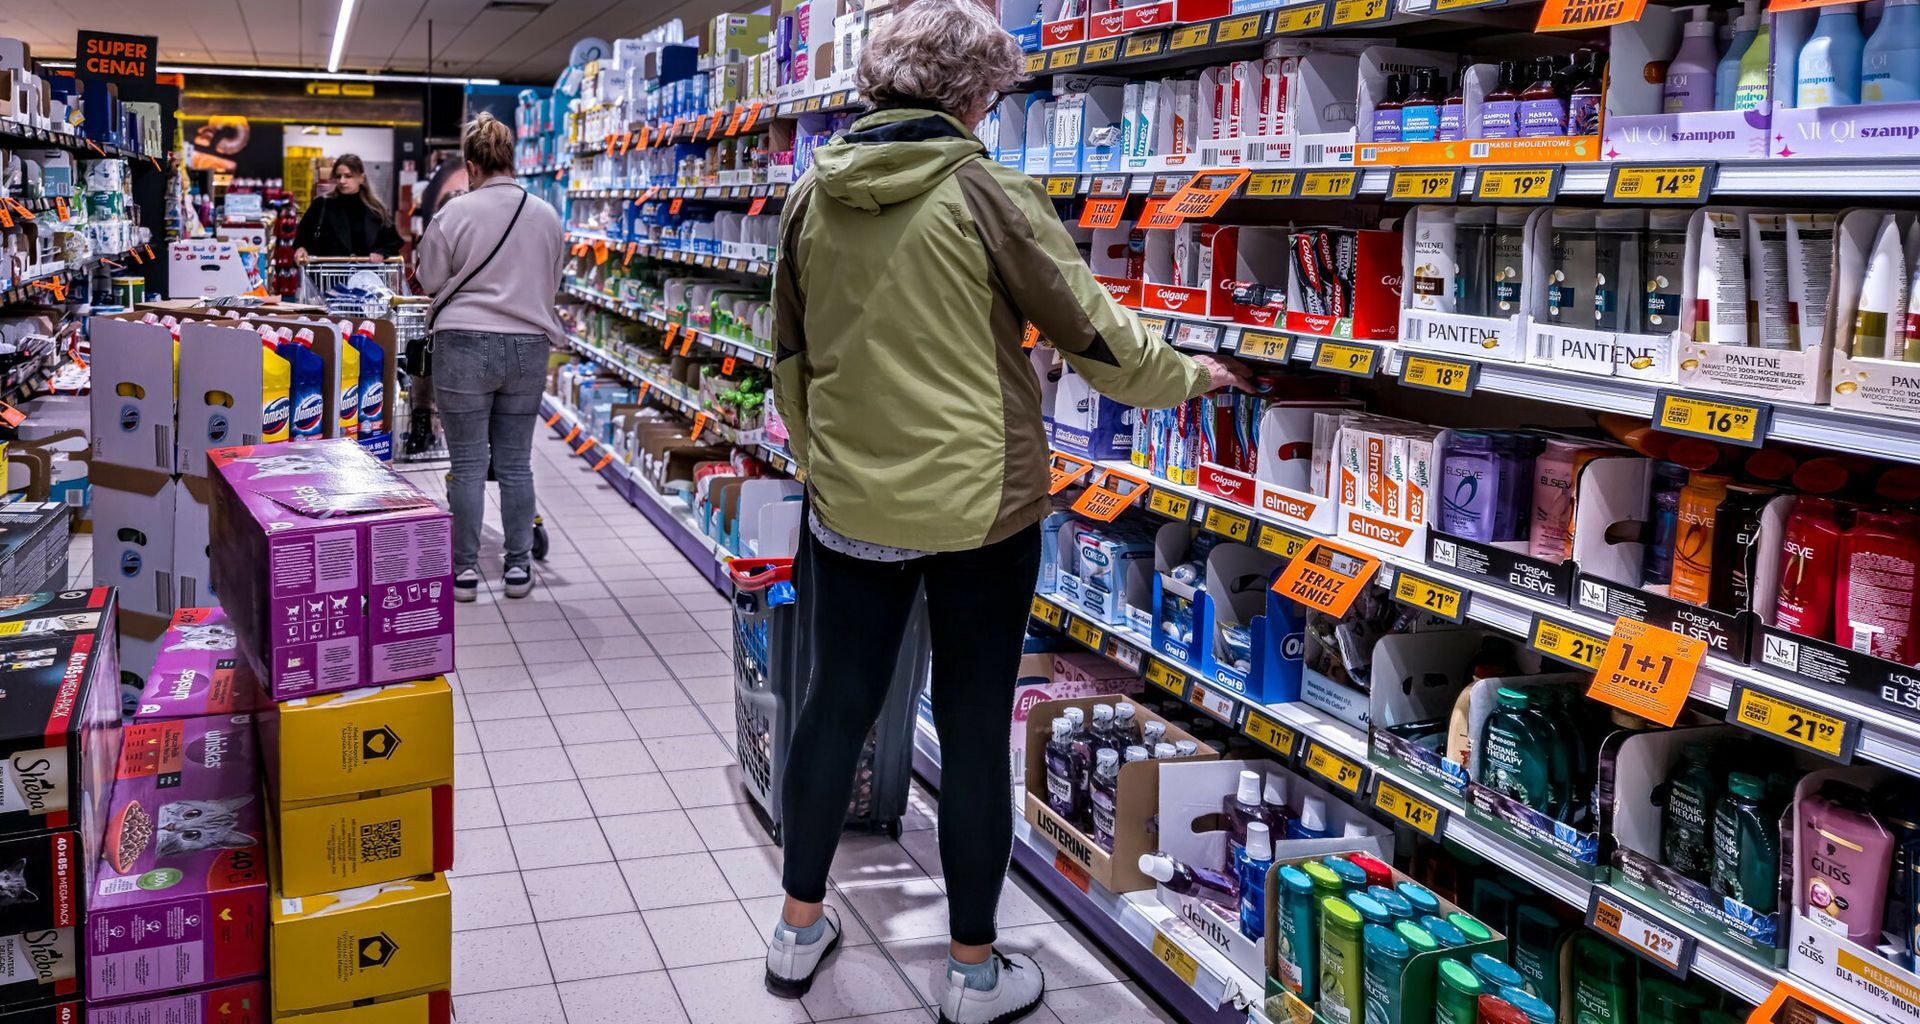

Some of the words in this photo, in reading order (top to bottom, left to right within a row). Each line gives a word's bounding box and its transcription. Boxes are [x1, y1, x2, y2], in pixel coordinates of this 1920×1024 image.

[1136, 7, 1159, 20] Colgate
[1562, 1, 1621, 25] TANIEJ
[1051, 24, 1074, 35] Colgate
[87, 39, 147, 59] SUPER
[86, 58, 145, 77] CENA!
[1489, 141, 1512, 149] MASKI
[1514, 140, 1571, 148] EMOLIENTOWE
[1672, 130, 1735, 143] szampon
[1267, 143, 1291, 151] LACALUT
[1328, 177, 1350, 193] 1199
[1421, 178, 1448, 194] 1999
[1513, 176, 1545, 194] 1999
[1655, 175, 1695, 194] 1499
[1184, 193, 1219, 203] TERAZ
[1094, 204, 1117, 213] TERAZ
[1175, 204, 1210, 213] TANIEJ
[1090, 215, 1113, 224] TANIEJ
[1150, 215, 1176, 224] TANIEJ
[1302, 239, 1316, 284] Colgate
[1157, 288, 1190, 302] Colgate
[1250, 310, 1271, 319] Colgate
[1305, 317, 1329, 326] Colgate
[1428, 322, 1500, 347] PANTENE
[1349, 354, 1368, 369] 999
[1702, 363, 1725, 371] NAWET
[1726, 354, 1780, 369] PANTENE
[1436, 368, 1464, 386] 1899
[1702, 369, 1738, 378] WIDOCZNIE
[1739, 374, 1779, 382] ZDROWSZE
[1780, 378, 1806, 386] WŁOSY
[1861, 392, 1907, 404] WIDOCZNIE
[1862, 386, 1890, 394] NAWET
[1707, 411, 1748, 432] 1699
[1370, 442, 1381, 494] elmex
[1210, 473, 1241, 488] Colgate
[1092, 492, 1120, 507] TERAZ
[1266, 495, 1308, 518] elmex
[1084, 501, 1112, 517] TANIEJ
[1679, 510, 1715, 528] ELSEVE
[1352, 518, 1400, 544] elmex
[1084, 549, 1106, 566] COREGA
[1514, 562, 1552, 580] L'ORÉAL
[1300, 568, 1345, 594] TERAZ
[1510, 572, 1556, 596] ELSEVE
[1291, 581, 1336, 608] TANIEJ
[1427, 589, 1455, 606] 2199
[1677, 610, 1724, 631] L'ORÉAL
[1165, 642, 1187, 659] Oral-B
[1619, 643, 1673, 684] 1+1
[1218, 672, 1243, 690] Oral-B
[1745, 711, 1766, 722] CENY
[1785, 714, 1835, 742] 2199
[1270, 729, 1290, 746] 1199
[205, 730, 228, 768] whiskas
[1486, 747, 1523, 767] THERAPY
[14, 757, 55, 811] Sheba
[1404, 801, 1433, 824] 1499
[1670, 803, 1706, 826] THERAPY
[1038, 810, 1092, 867] LISTERINE
[57, 838, 69, 877] 40x85g
[1812, 857, 1851, 886] GLISS
[57, 877, 69, 925] MEGA-PACK
[1597, 914, 1618, 930] CENA
[1598, 907, 1620, 922] SUPER
[1182, 903, 1231, 952] dentix
[1644, 929, 1674, 951] 1299
[23, 930, 58, 979] Sheba
[1798, 945, 1824, 965] GLISS
[1836, 967, 1853, 983] DLA
[1855, 979, 1890, 1002] +100%
[1576, 993, 1611, 1018] FRUCTIS
